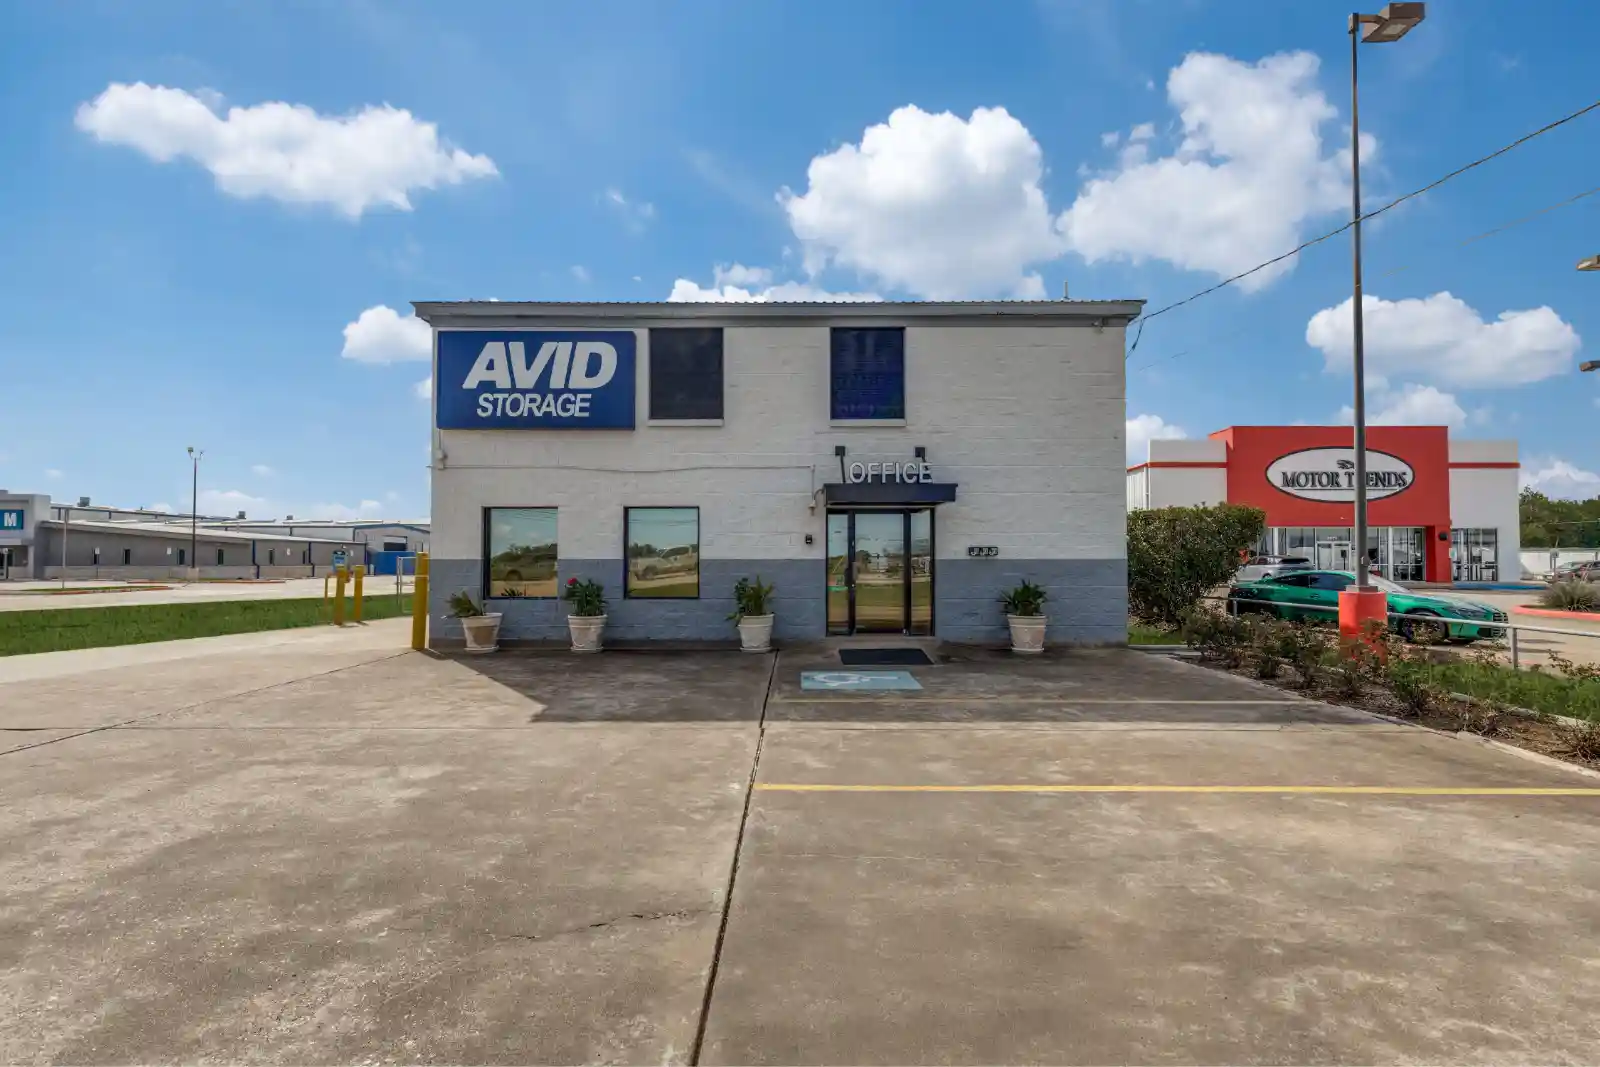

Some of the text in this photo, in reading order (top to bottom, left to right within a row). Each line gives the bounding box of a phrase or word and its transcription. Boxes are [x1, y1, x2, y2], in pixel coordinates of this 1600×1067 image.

[462, 342, 618, 389] AVID
[477, 393, 592, 418] STORAGE
[849, 462, 933, 483] OFFICE
[1281, 471, 1408, 488] MOTOR TENDS
[3, 512, 17, 527] M
